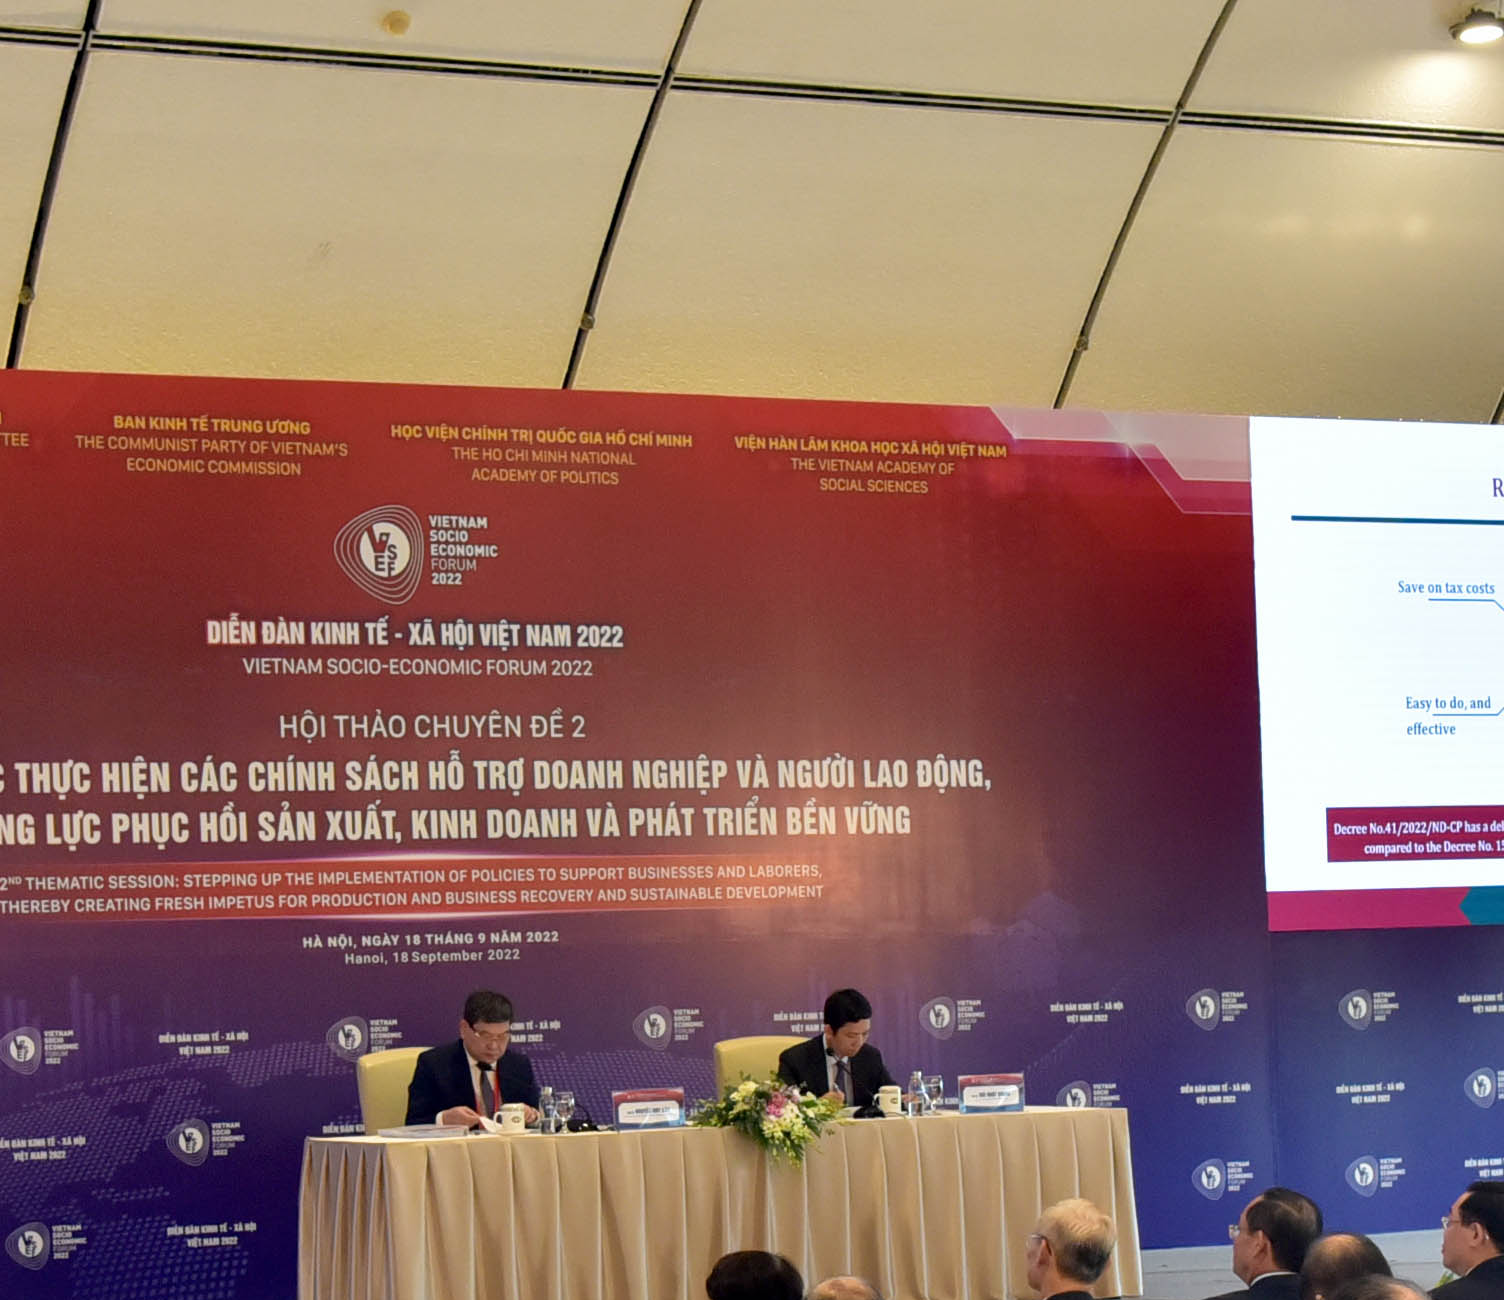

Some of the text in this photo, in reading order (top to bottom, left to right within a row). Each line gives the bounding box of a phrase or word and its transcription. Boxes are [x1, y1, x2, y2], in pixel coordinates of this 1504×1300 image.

[819, 477, 929, 494] SOCIAL SCIENCES
[428, 515, 488, 529] VIETNAM
[429, 529, 469, 543] SOCIO
[430, 543, 498, 557] ECONOMIC
[431, 558, 477, 571] FORUM
[431, 572, 462, 585] 2022
[1398, 580, 1496, 594] Save on tax costs
[207, 612, 256, 645] DIỄN
[261, 616, 305, 645] ĐÀN
[310, 621, 360, 645] KINH
[364, 615, 389, 645] TẾ
[408, 618, 436, 646] XÃ
[440, 618, 474, 651] HỘI
[479, 619, 521, 651] VIỆT
[526, 624, 572, 647] NAM
[577, 625, 624, 648] 2022
[1406, 695, 1491, 713] Easy to do, and
[280, 707, 586, 744] HỘI THẢO CHUYÊN ĐỀ 2
[1407, 722, 1456, 736] effective
[14, 759, 91, 800] THỰC
[101, 755, 170, 800] HIỆN
[180, 755, 238, 793] CÁC
[248, 755, 335, 792] CHÍNH
[345, 754, 419, 791] SÁCH
[428, 749, 464, 790] HỖ
[473, 757, 524, 796] TRỢ
[533, 760, 623, 790] DOANH
[632, 753, 728, 795] NGHIỆP
[736, 754, 770, 790] VÀ
[777, 752, 855, 789] NGƯỜI
[863, 759, 908, 788] LAO
[916, 753, 991, 794] ĐỘNG,
[1333, 823, 1368, 835] Decree
[1369, 820, 1463, 837] No.41/2022/ND-CP
[1464, 820, 1481, 833] has
[1482, 823, 1489, 832] a
[345, 948, 520, 965] Hanoi, 18 September 2022
